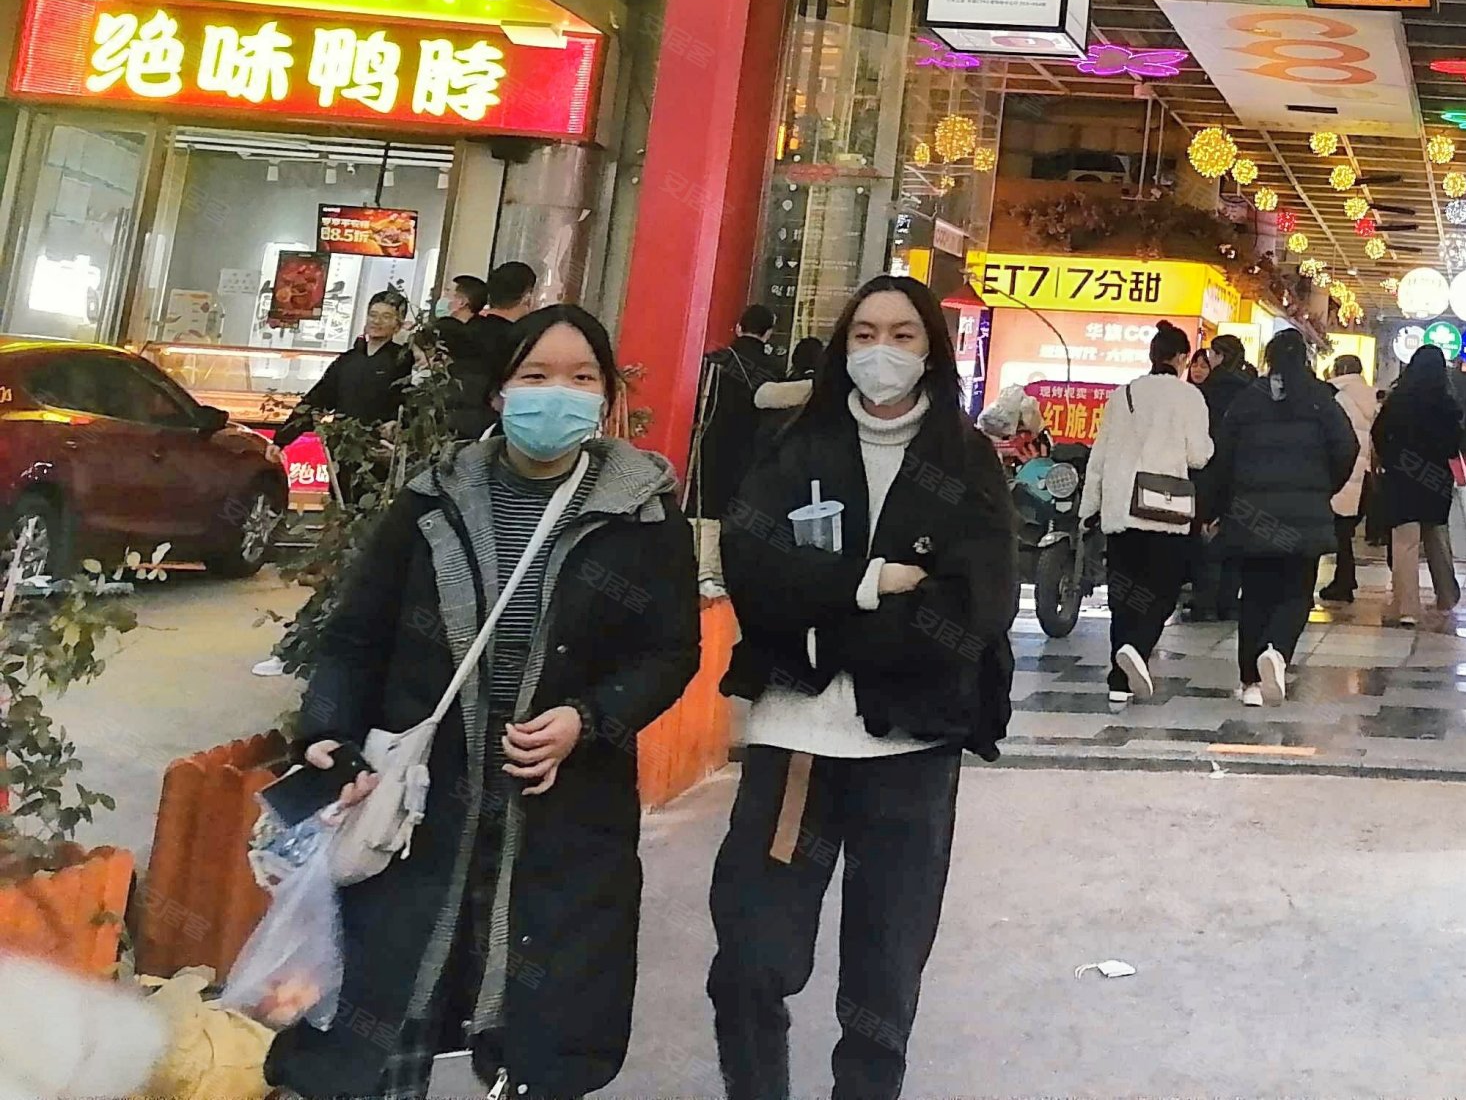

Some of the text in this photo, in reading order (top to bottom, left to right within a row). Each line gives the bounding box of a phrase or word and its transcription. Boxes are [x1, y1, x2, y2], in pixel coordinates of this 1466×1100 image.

[86, 9, 508, 122] 绝味鸭脖
[1066, 267, 1163, 303] 7分甜
